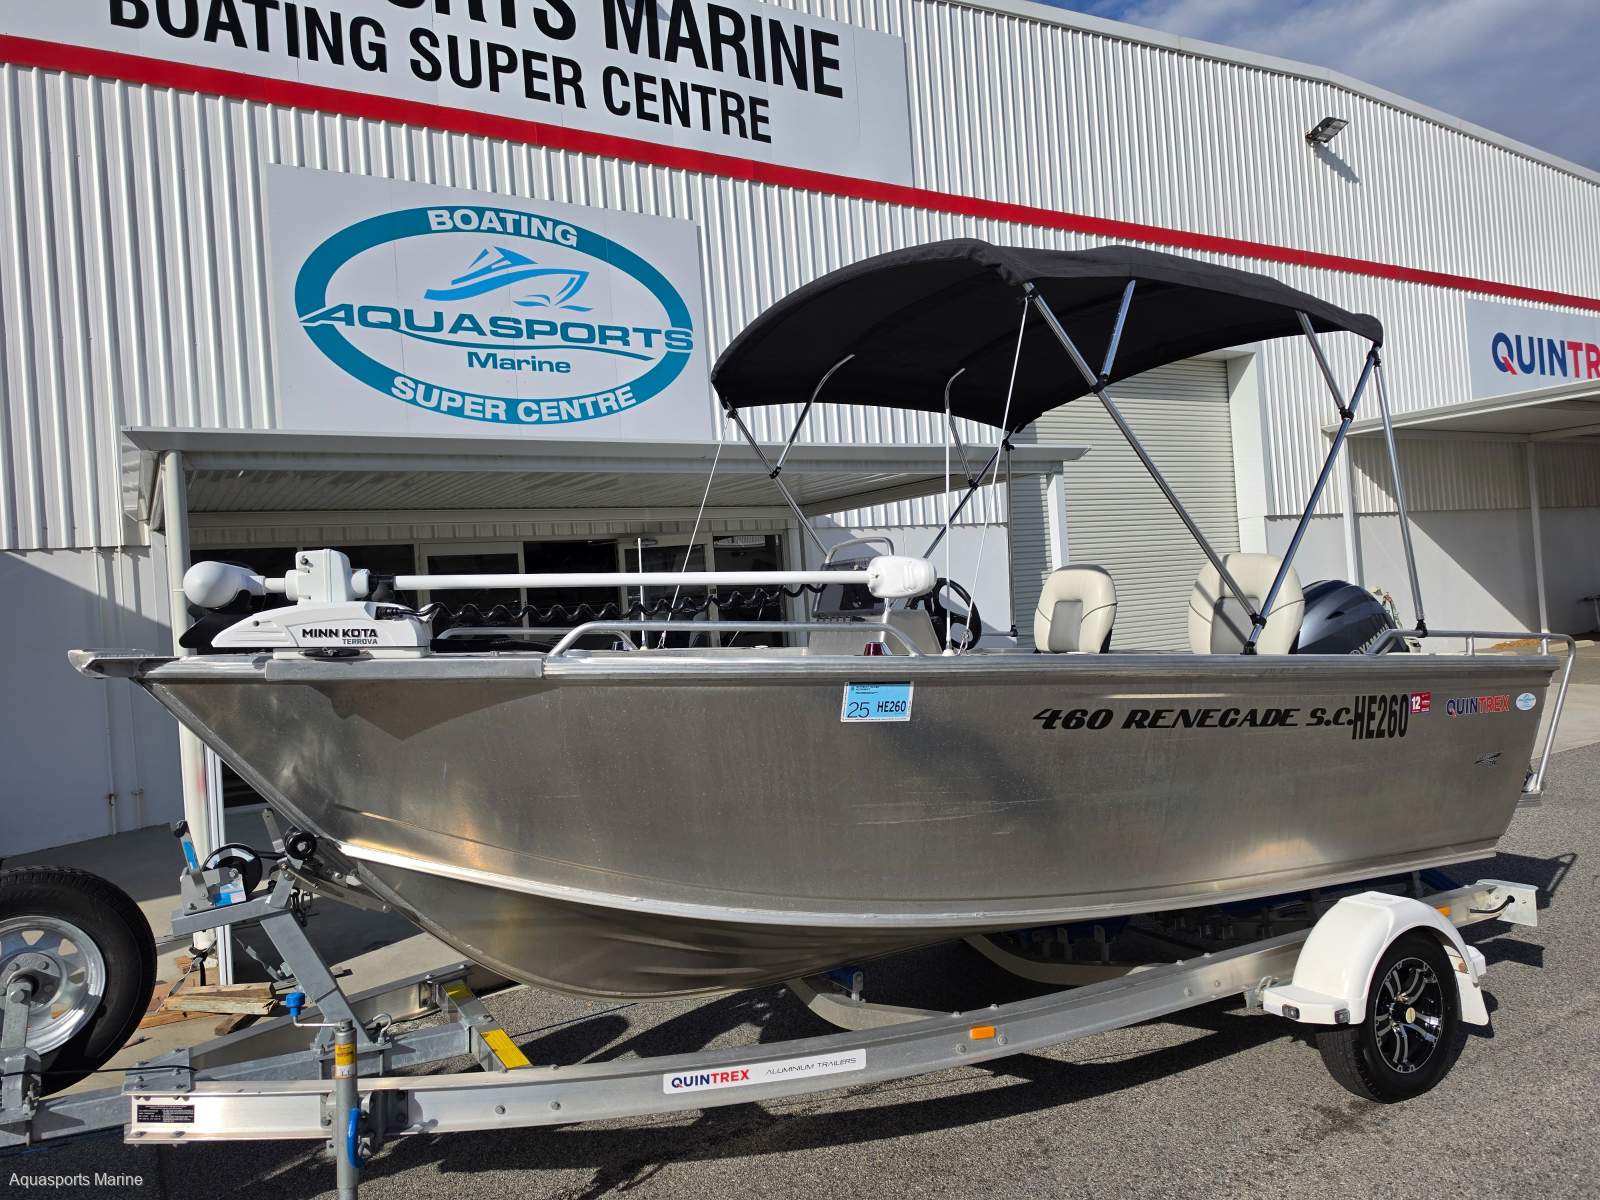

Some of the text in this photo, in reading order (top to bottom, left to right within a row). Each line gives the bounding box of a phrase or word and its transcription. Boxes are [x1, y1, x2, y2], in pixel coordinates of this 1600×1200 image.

[602, 0, 843, 99] MARINE
[409, 27, 587, 109] SUPER
[602, 66, 772, 144] CENTRE
[427, 209, 578, 247] BOATING
[299, 303, 694, 352] AQUASPORTS
[467, 351, 571, 374] Marine
[390, 376, 636, 422] SUPER CENTRE
[302, 628, 378, 638] MINN KOTA
[847, 700, 907, 719] 25 HE260
[1352, 693, 1409, 740] HE260
[1411, 695, 1421, 710] 12
[1446, 695, 1510, 717] QUINTREX
[1032, 708, 1114, 730] 460
[1120, 707, 1300, 730] RENEGADE
[671, 1057, 857, 1088] QUINTREX ALUMINIUM TRAILERS
